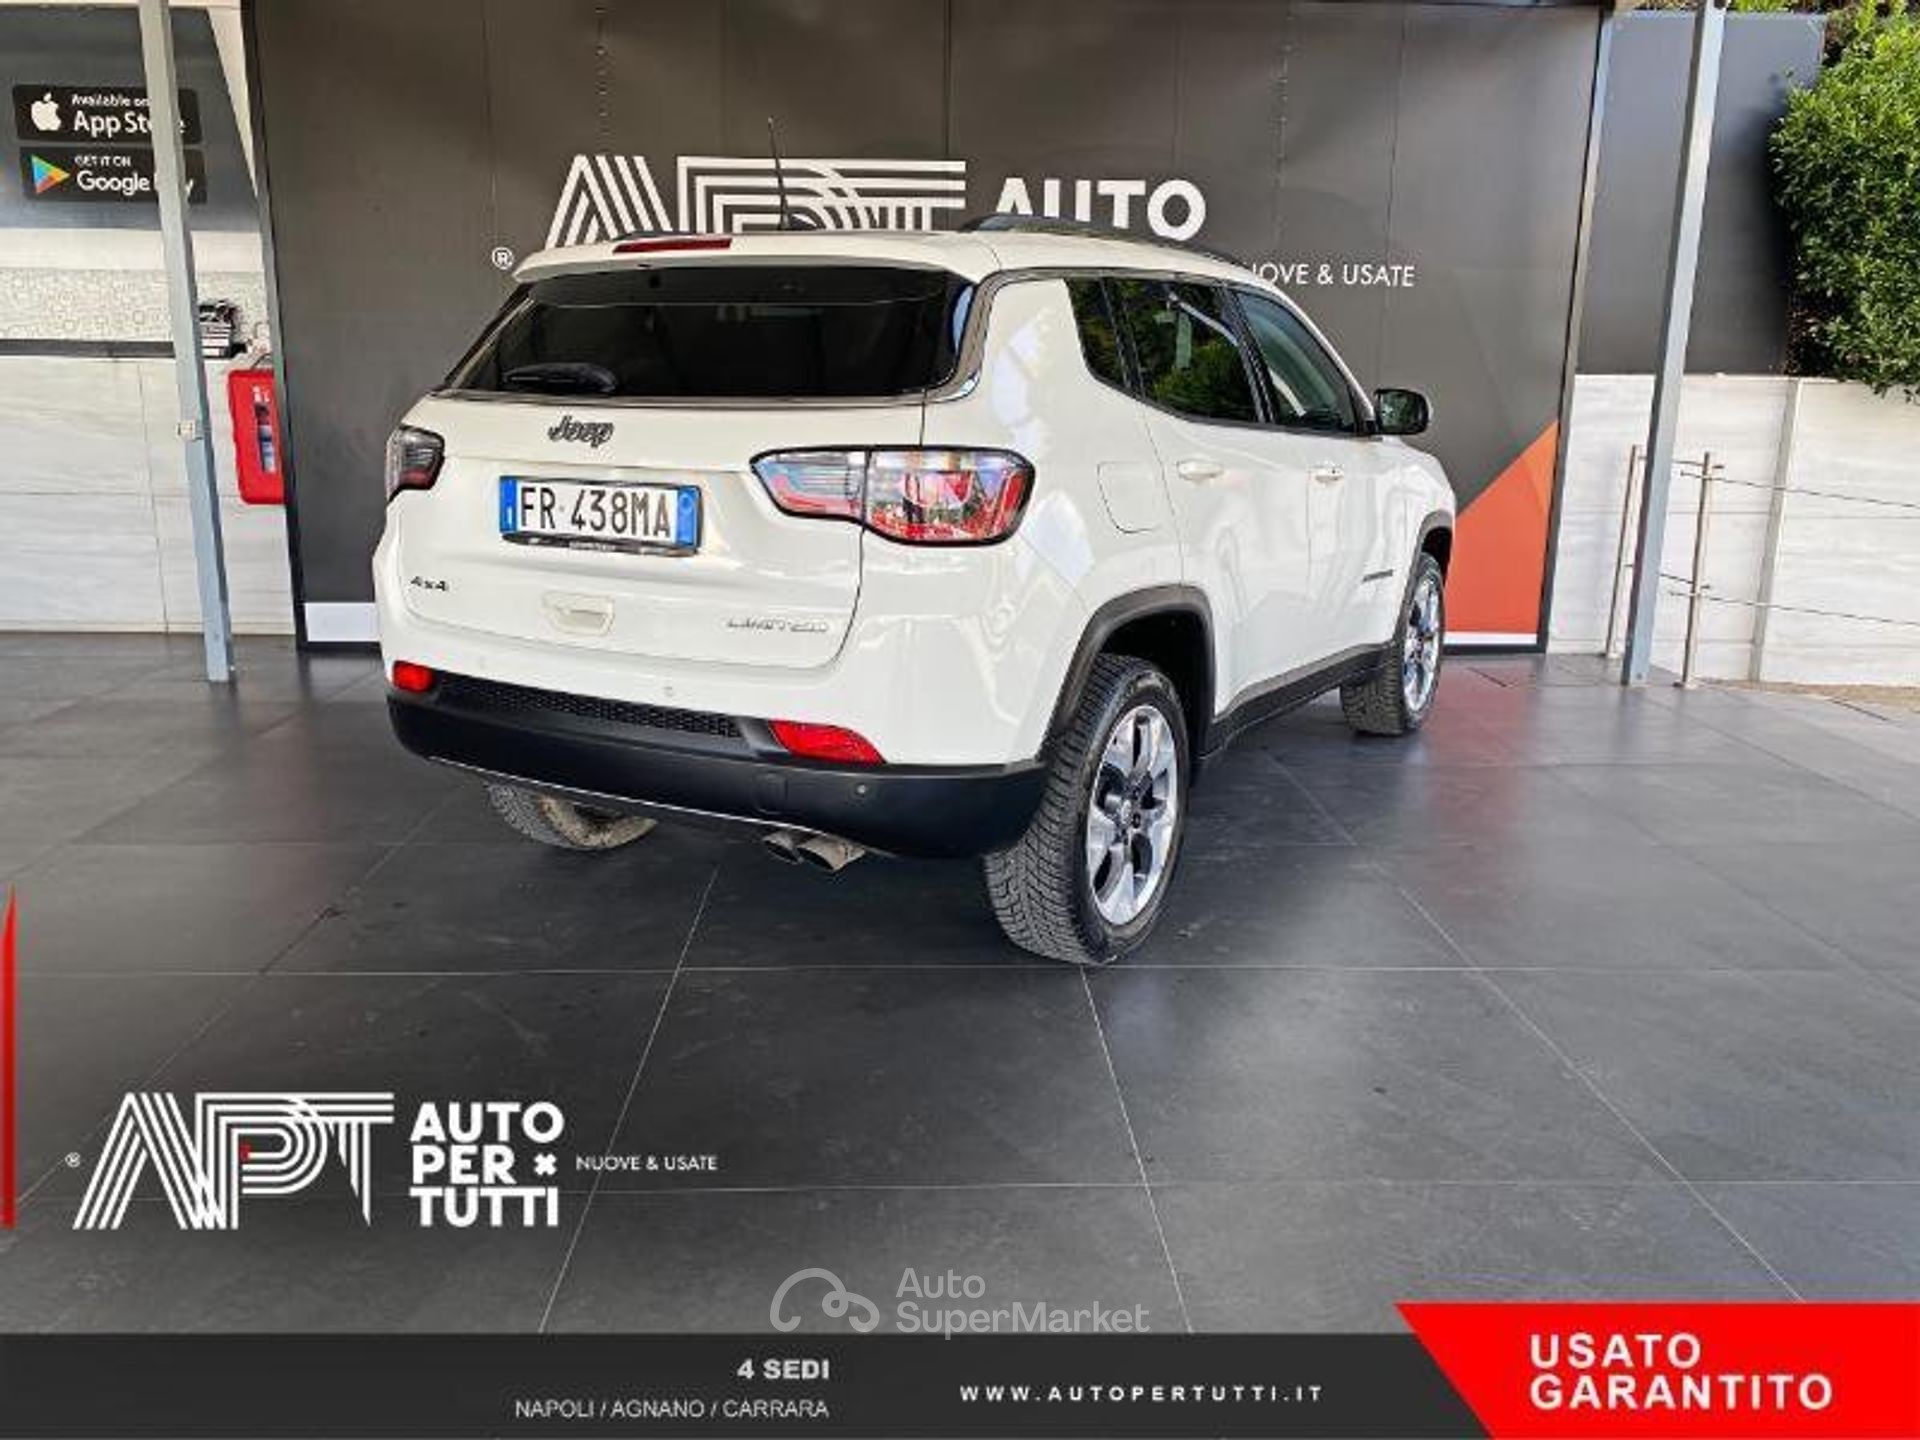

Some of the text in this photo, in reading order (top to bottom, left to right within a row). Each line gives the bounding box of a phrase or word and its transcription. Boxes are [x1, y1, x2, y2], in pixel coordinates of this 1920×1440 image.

[73, 110, 121, 138] App
[74, 155, 97, 167] GET
[76, 170, 150, 196] Google
[1317, 264, 1334, 284] &
[1343, 264, 1415, 287] USATE
[547, 415, 615, 449] Jeep
[520, 486, 671, 539] FR 438MA
